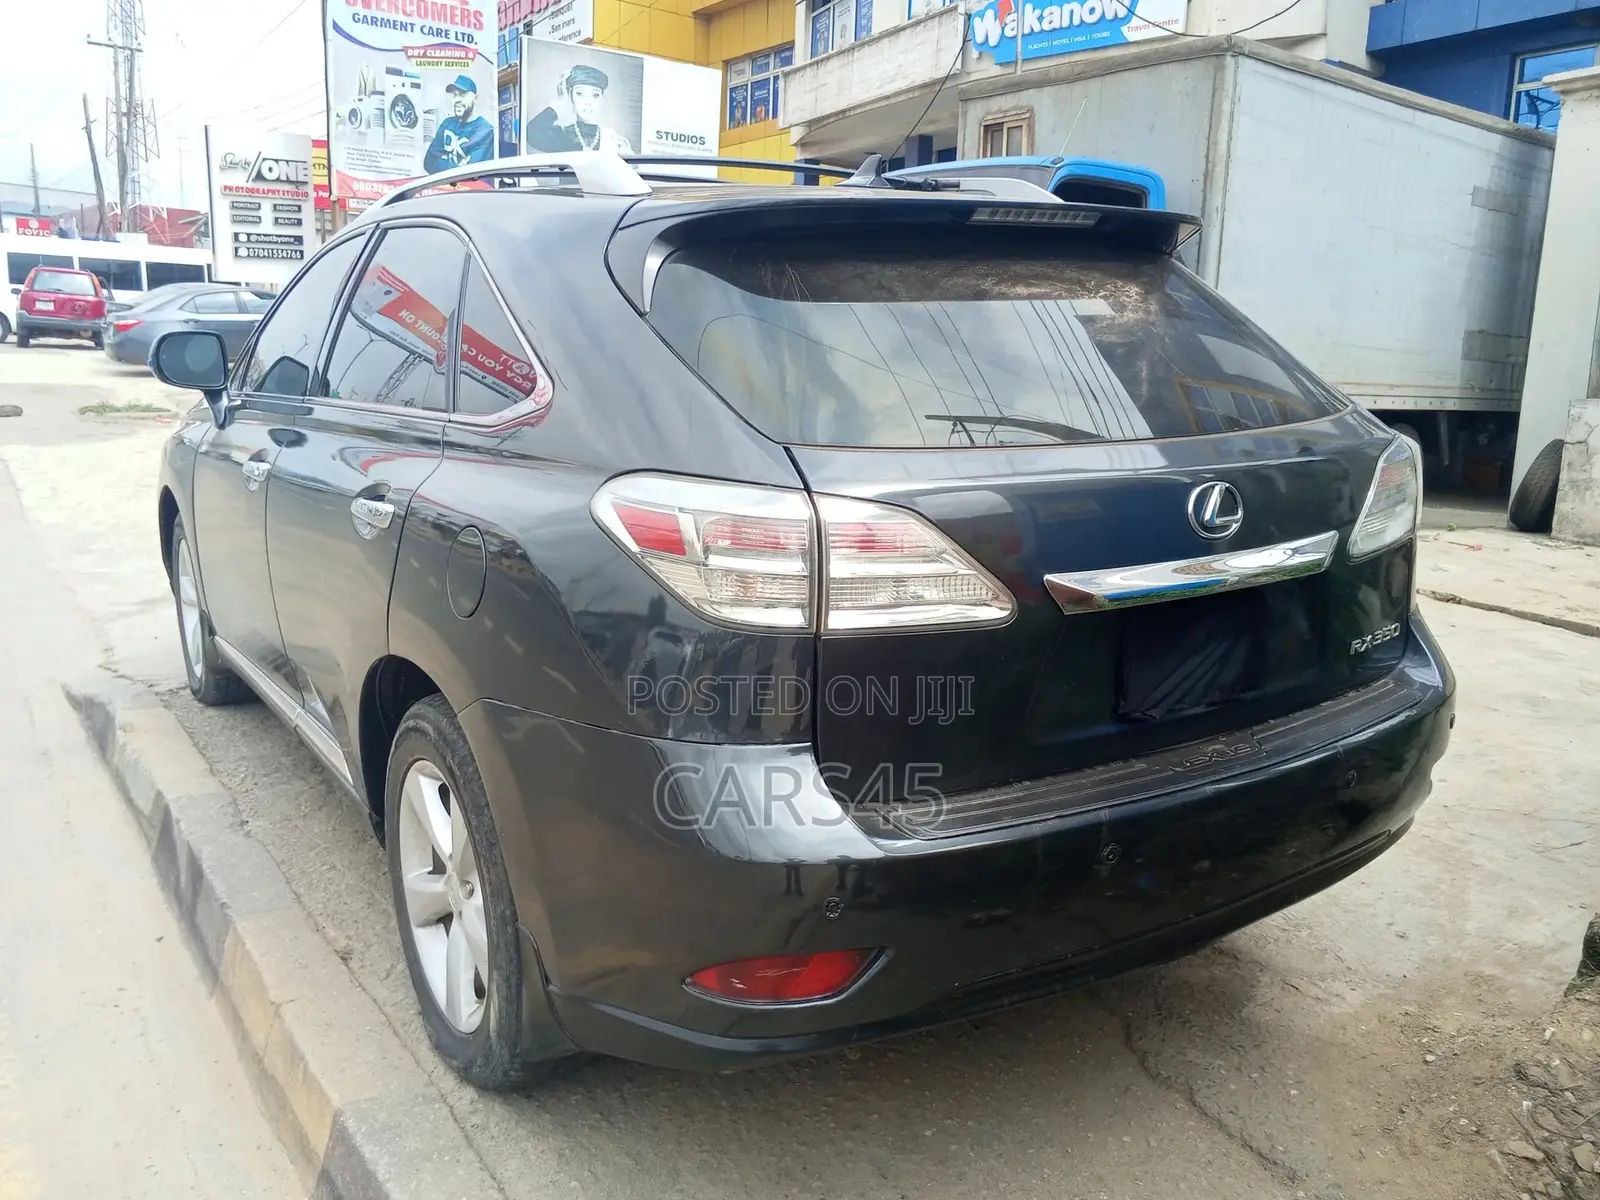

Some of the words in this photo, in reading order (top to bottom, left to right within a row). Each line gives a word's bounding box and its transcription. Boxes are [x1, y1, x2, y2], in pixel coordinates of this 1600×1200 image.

[352, 12, 416, 33] GARMENT
[420, 24, 451, 40] CARE
[454, 31, 478, 45] LTD.
[972, 0, 1129, 47] Wakanow
[1127, 22, 1151, 33] Travel
[1153, 18, 1179, 29] Centre
[557, 29, 582, 42] ference
[1027, 41, 1049, 50] FLIGHTS
[1052, 38, 1070, 46] HOTEL
[1073, 35, 1087, 43] VISA
[1091, 31, 1111, 40] TOURS
[407, 48, 425, 56] DRY
[426, 49, 466, 58] CLEANING
[444, 60, 470, 68] SERVICES
[656, 130, 706, 146] STUDIOS
[223, 185, 280, 196] PHOTOGRAPHY
[281, 189, 309, 198] STUDIO
